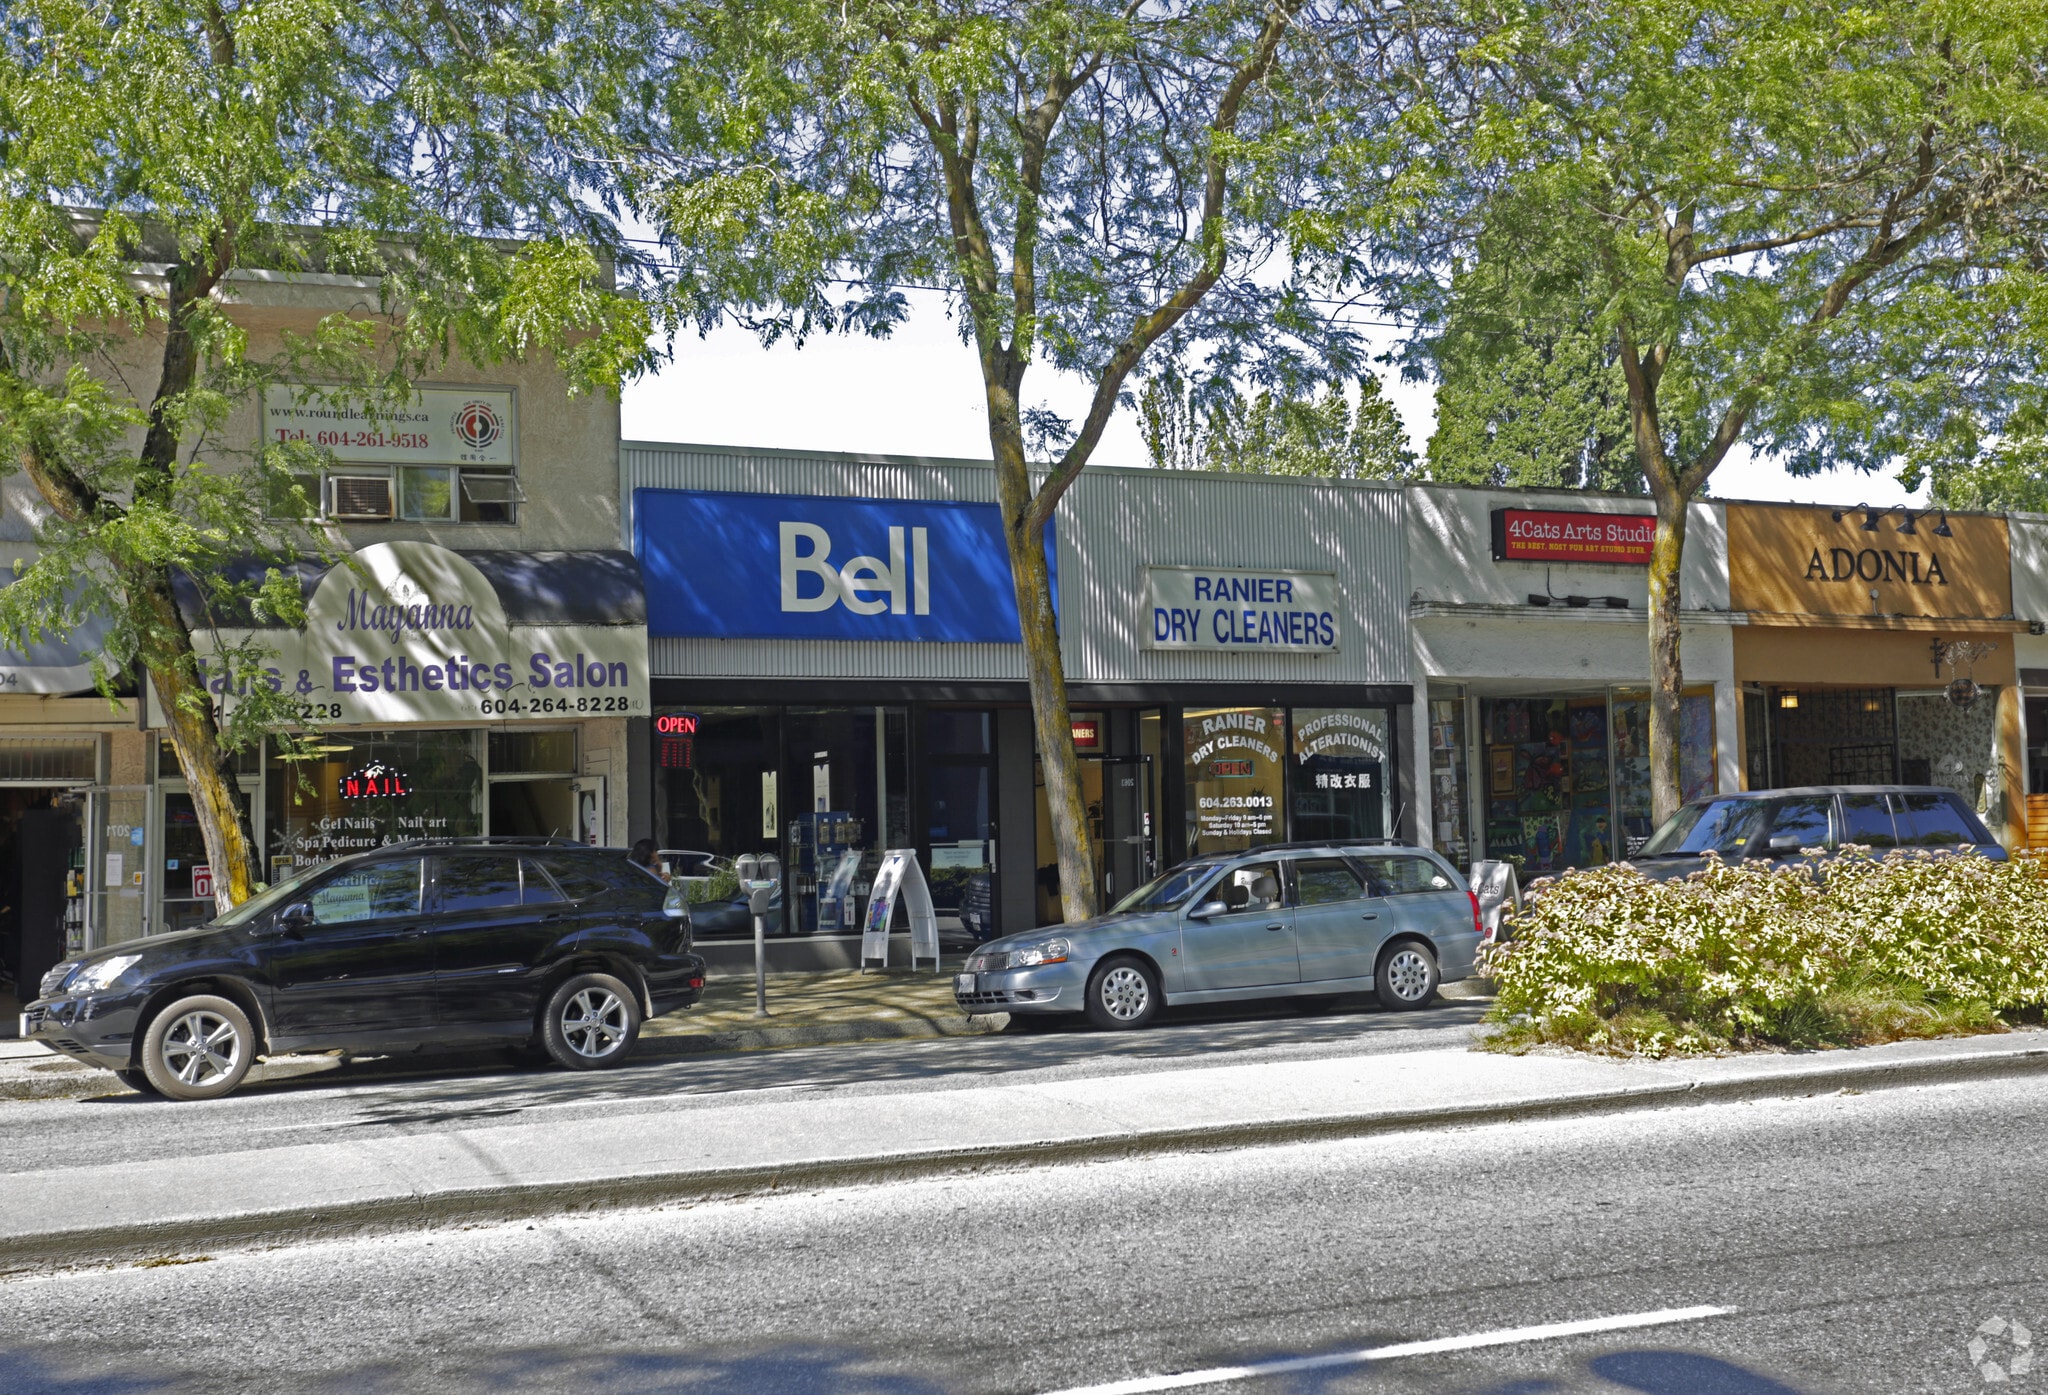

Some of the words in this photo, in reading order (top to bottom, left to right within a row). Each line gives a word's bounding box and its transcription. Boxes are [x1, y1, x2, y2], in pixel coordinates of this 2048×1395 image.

[317, 430, 429, 449] 604-261-9518
[1509, 520, 1560, 538] 4Cats
[1563, 523, 1602, 540] Arts
[779, 521, 930, 615] Bell
[1804, 547, 1949, 585] ADONIA
[1194, 576, 1293, 603] RANIER
[337, 588, 474, 645] Mayanna
[1154, 608, 1201, 642] DRY
[1213, 608, 1335, 646] CLEANERS
[296, 669, 313, 693] &
[332, 656, 513, 693] Esthetics
[529, 652, 629, 688] Salon
[481, 696, 629, 715] 604-264-8228
[657, 716, 696, 733] OPEN
[1071, 728, 1095, 739] ANERS
[1202, 713, 1266, 736] RANIER
[1298, 714, 1382, 742] PROFESSIONAL
[1191, 740, 1214, 765] DRY
[1217, 735, 1278, 763] CLEANERS
[1299, 733, 1386, 765] ALTERATIONIST
[1209, 762, 1251, 775] OPEN
[346, 777, 406, 797] NAIL
[1315, 773, 1371, 789] 精改衣服
[1199, 796, 1273, 809] 604.263.0013
[320, 817, 341, 830] Gel
[344, 817, 375, 830] Nails
[398, 816, 423, 828] Nail
[428, 817, 447, 828] art
[296, 836, 319, 851] Spa
[322, 835, 377, 848] Pedicure
[381, 834, 393, 847] &
